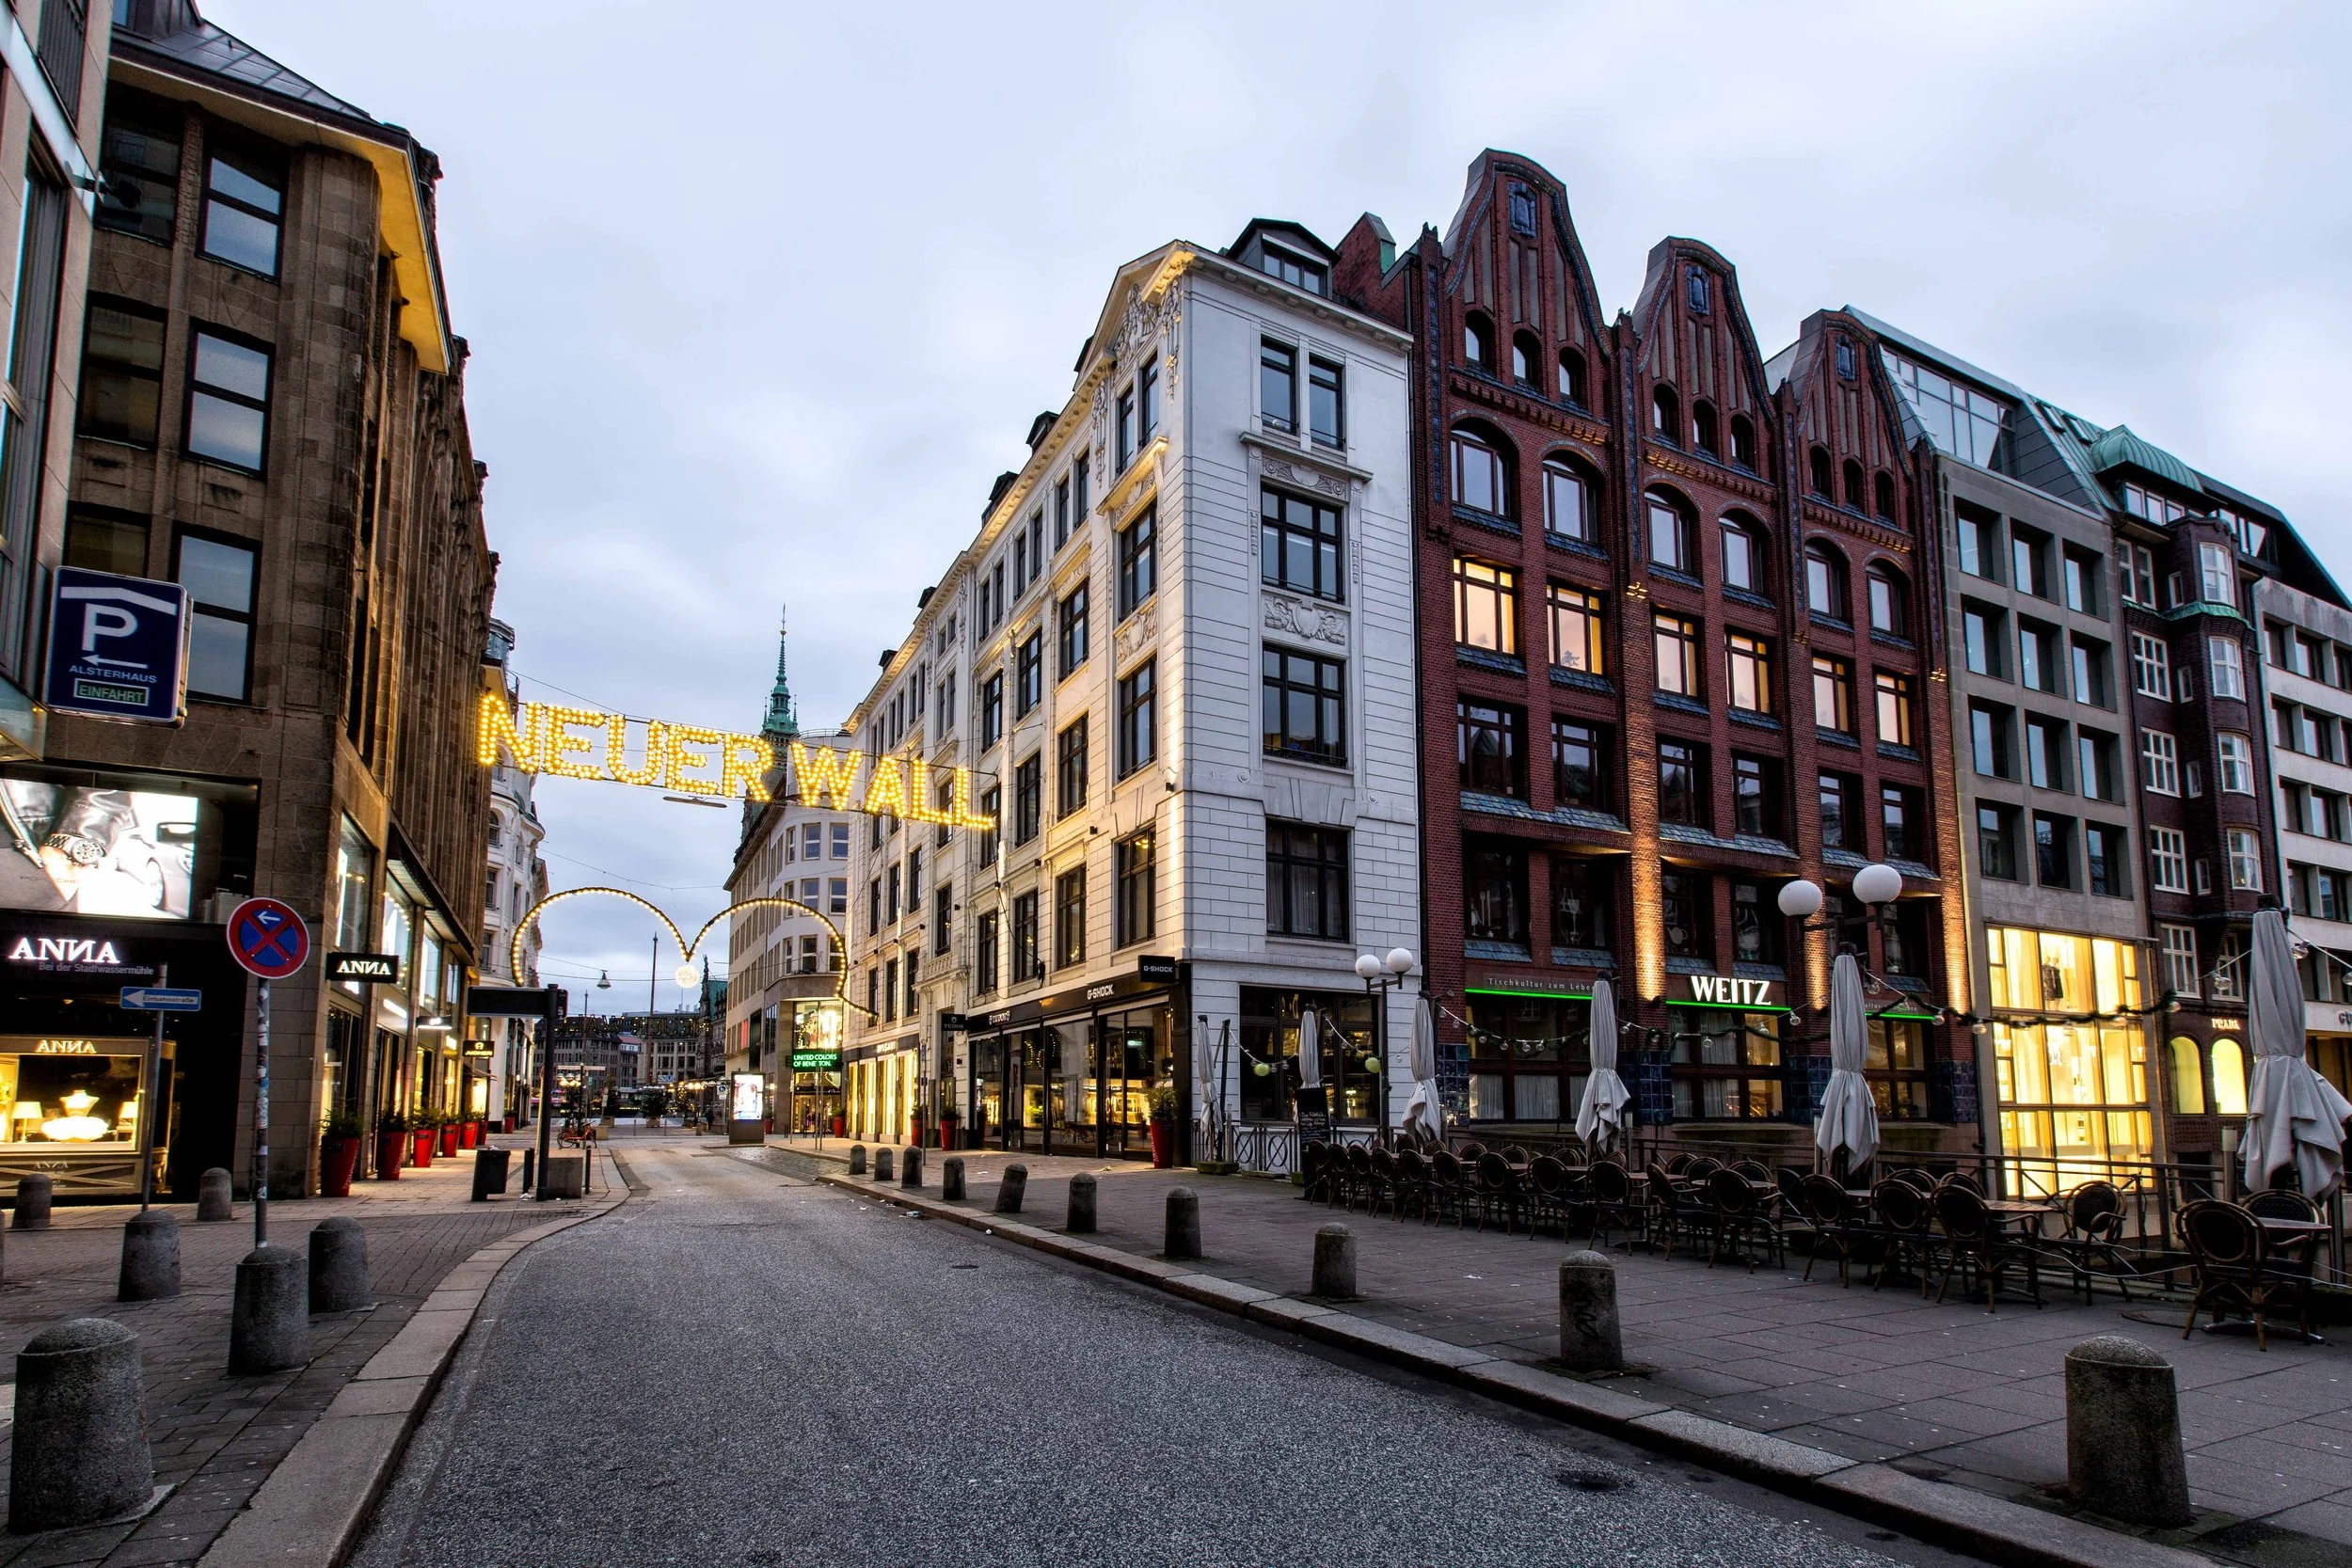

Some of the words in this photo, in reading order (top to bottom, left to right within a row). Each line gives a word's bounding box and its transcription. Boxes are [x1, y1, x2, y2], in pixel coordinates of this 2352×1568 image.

[82, 603, 138, 652] P
[69, 665, 157, 683] ALSTERHAUS
[79, 685, 144, 703] EINFAHRT
[478, 695, 772, 802] NEUER
[790, 741, 997, 831] WALL
[40, 962, 54, 971] Bei
[56, 963, 72, 972] der
[75, 964, 153, 975] Stadtwassermühle
[1087, 984, 1114, 1000] G-SHOCK
[1488, 977, 1543, 989] Tischkultur
[1691, 975, 1772, 1006] WEITZ
